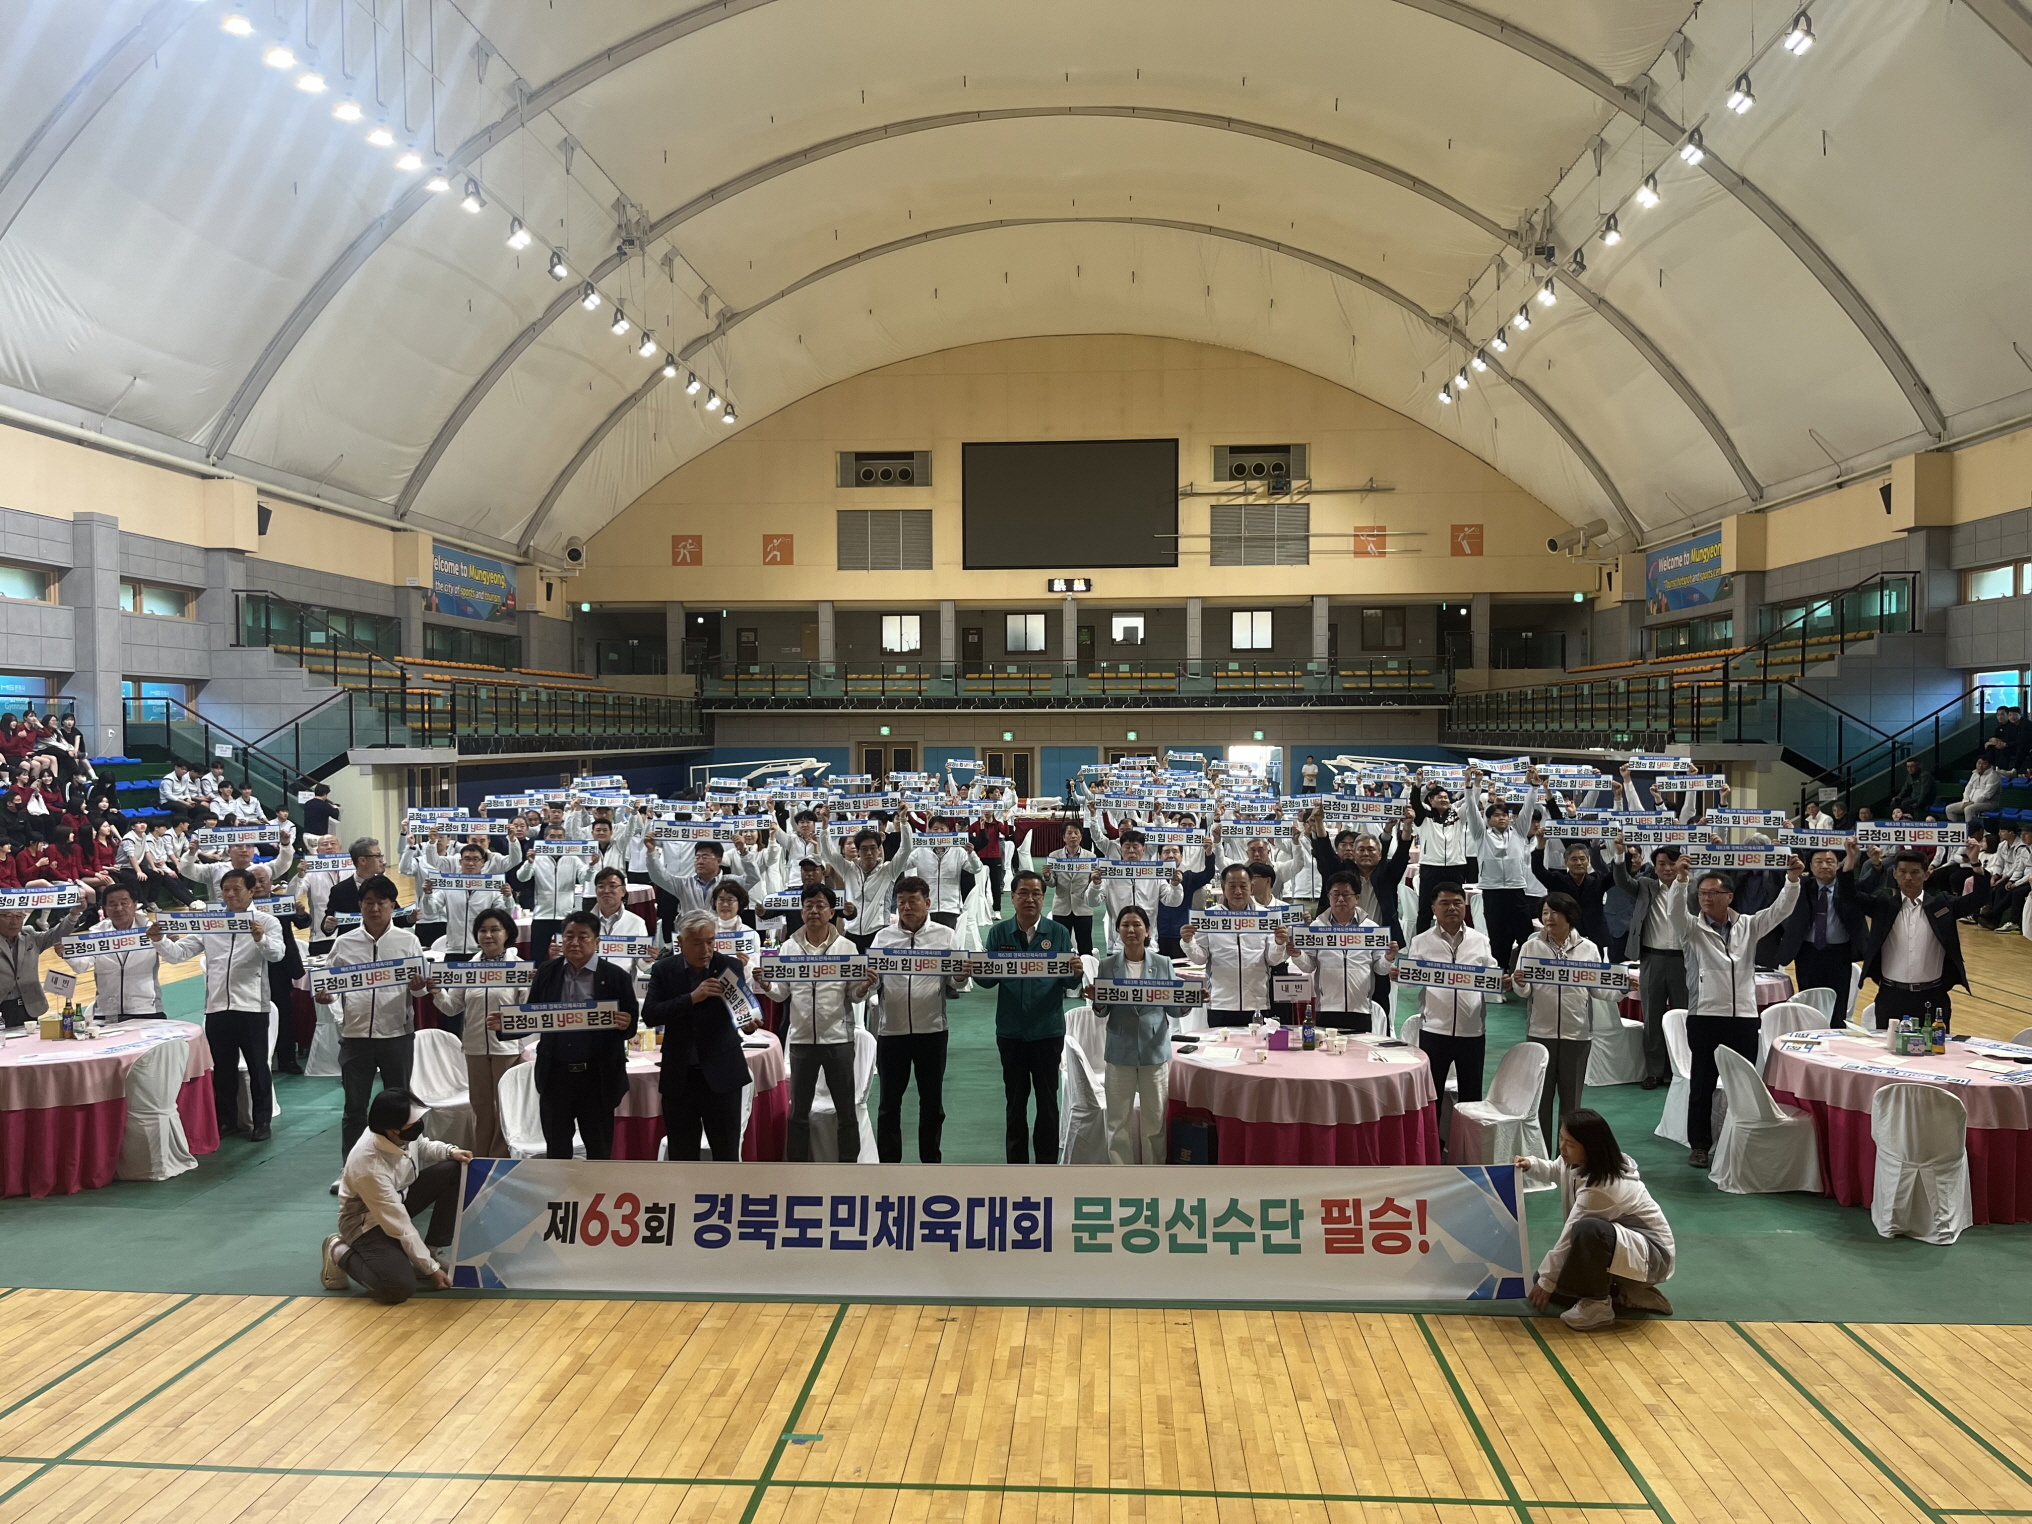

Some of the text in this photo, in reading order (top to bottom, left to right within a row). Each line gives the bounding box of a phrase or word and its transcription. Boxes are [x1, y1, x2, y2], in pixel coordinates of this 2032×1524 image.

[1659, 542, 1722, 573] Welcome to Mungyeon
[434, 555, 506, 589] elcome to Mungyeong,
[435, 580, 444, 591] the
[444, 583, 454, 595] city
[454, 585, 460, 595] of
[475, 590, 484, 600] and
[1657, 781, 1677, 790] 긍정의
[1689, 780, 1704, 788] yes
[829, 800, 850, 810] 긍정의
[862, 799, 879, 808] yes
[881, 797, 900, 808] 문경!
[1323, 801, 1404, 815] 긍정의 힘 yes 문경!
[1706, 815, 1783, 825] 긍정의 힘 yes 문경!
[655, 828, 732, 840] 긍정의 힘 yes 문경!
[1222, 826, 1243, 835] 긍정의
[1255, 826, 1271, 835] yes
[1274, 826, 1292, 835] 문경!
[1859, 830, 1964, 842] 긍정의 힘 yes 문경!
[201, 834, 224, 844] 긍정의
[238, 832, 256, 842] yes
[259, 831, 278, 841] 문경!
[1624, 832, 1710, 843] 긍정의 힘 yes 문경!
[1780, 835, 1842, 847] 긍정의 힘 yes
[307, 860, 329, 870] 긍정의
[341, 858, 353, 868] ye
[1690, 854, 1790, 866] 긍정의 힘 yes 문경!
[1100, 867, 1122, 876] 긍정의
[1125, 867, 1133, 876] 힘
[1136, 867, 1153, 876] yes
[430, 879, 452, 887] 긍정의
[465, 880, 482, 888] yes
[0, 896, 16, 908] 정의
[18, 896, 29, 907] 힘
[31, 894, 53, 906] yes
[158, 920, 188, 931] 긍정의
[189, 920, 200, 930] 힘
[202, 920, 225, 930] yes
[1191, 918, 1218, 929] 긍정의
[1222, 918, 1231, 929] 힘
[1234, 919, 1255, 930] yes
[64, 941, 95, 955] 긍정의
[98, 939, 109, 951] 힘
[112, 936, 137, 950] yes
[1295, 935, 1388, 947] 긍정의 힘 yes 문경!
[868, 958, 897, 970] 긍정의
[901, 958, 911, 971] 힘
[915, 959, 937, 971] yes
[973, 962, 1003, 975] 긍정의
[1006, 961, 1017, 974] 힘
[1020, 961, 1043, 974] yes
[432, 971, 462, 984] 긍정의
[465, 971, 476, 984] 힘
[479, 971, 502, 984] yes
[765, 964, 866, 979] 긍정의 힘 yes 문경!
[1523, 967, 1627, 986] 긍정의 힘 yes 문경!
[315, 975, 347, 993] 긍정의
[350, 973, 362, 987] 힘
[365, 969, 391, 985] yes
[1400, 968, 1500, 990] 긍정의 힘 yes 문경!
[1098, 988, 1199, 1004] 긍정의 힘 yes 문경!
[504, 1014, 537, 1030] 긍정의
[541, 1013, 553, 1028] 힘
[557, 1012, 583, 1028] yes
[543, 1192, 1430, 1255] 제63회 경북도민체육대회 문경선수단 필승!
